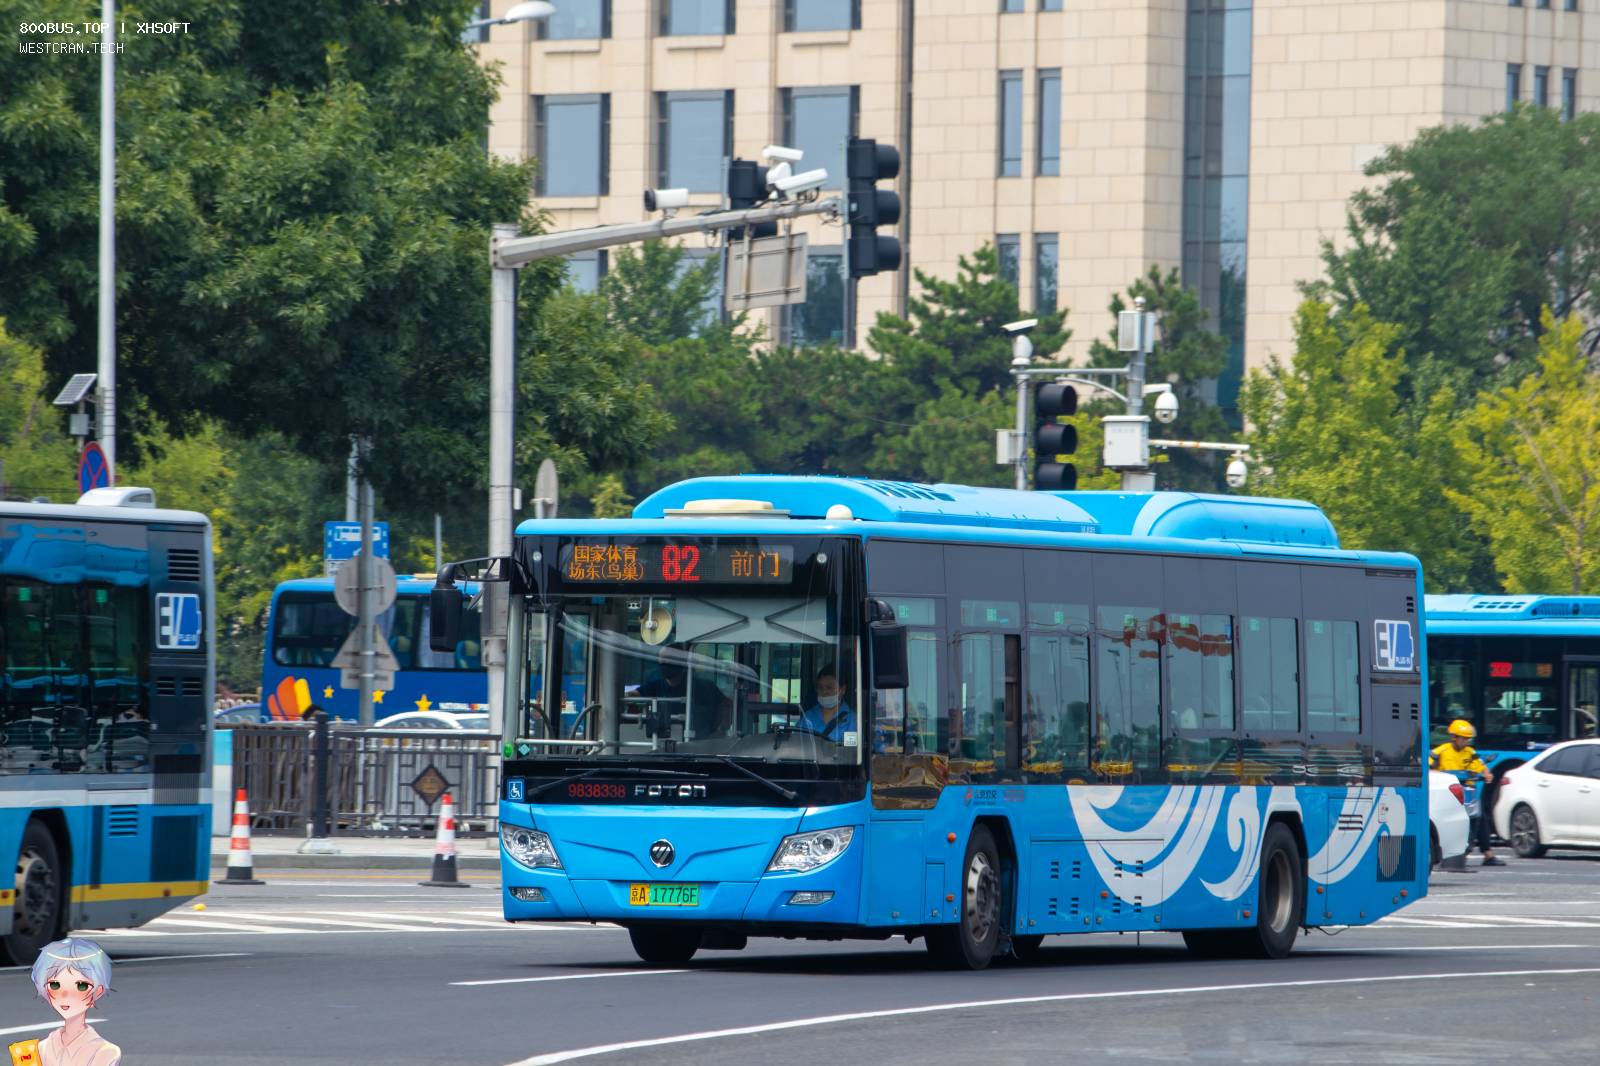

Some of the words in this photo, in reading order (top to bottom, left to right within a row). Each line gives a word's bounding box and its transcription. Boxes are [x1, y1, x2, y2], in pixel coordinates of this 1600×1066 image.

[574, 545, 640, 563] 国家体育
[661, 544, 700, 582] 82
[730, 550, 780, 577] 前门
[568, 783, 626, 798] 9838338
[634, 784, 706, 798] FOTON
